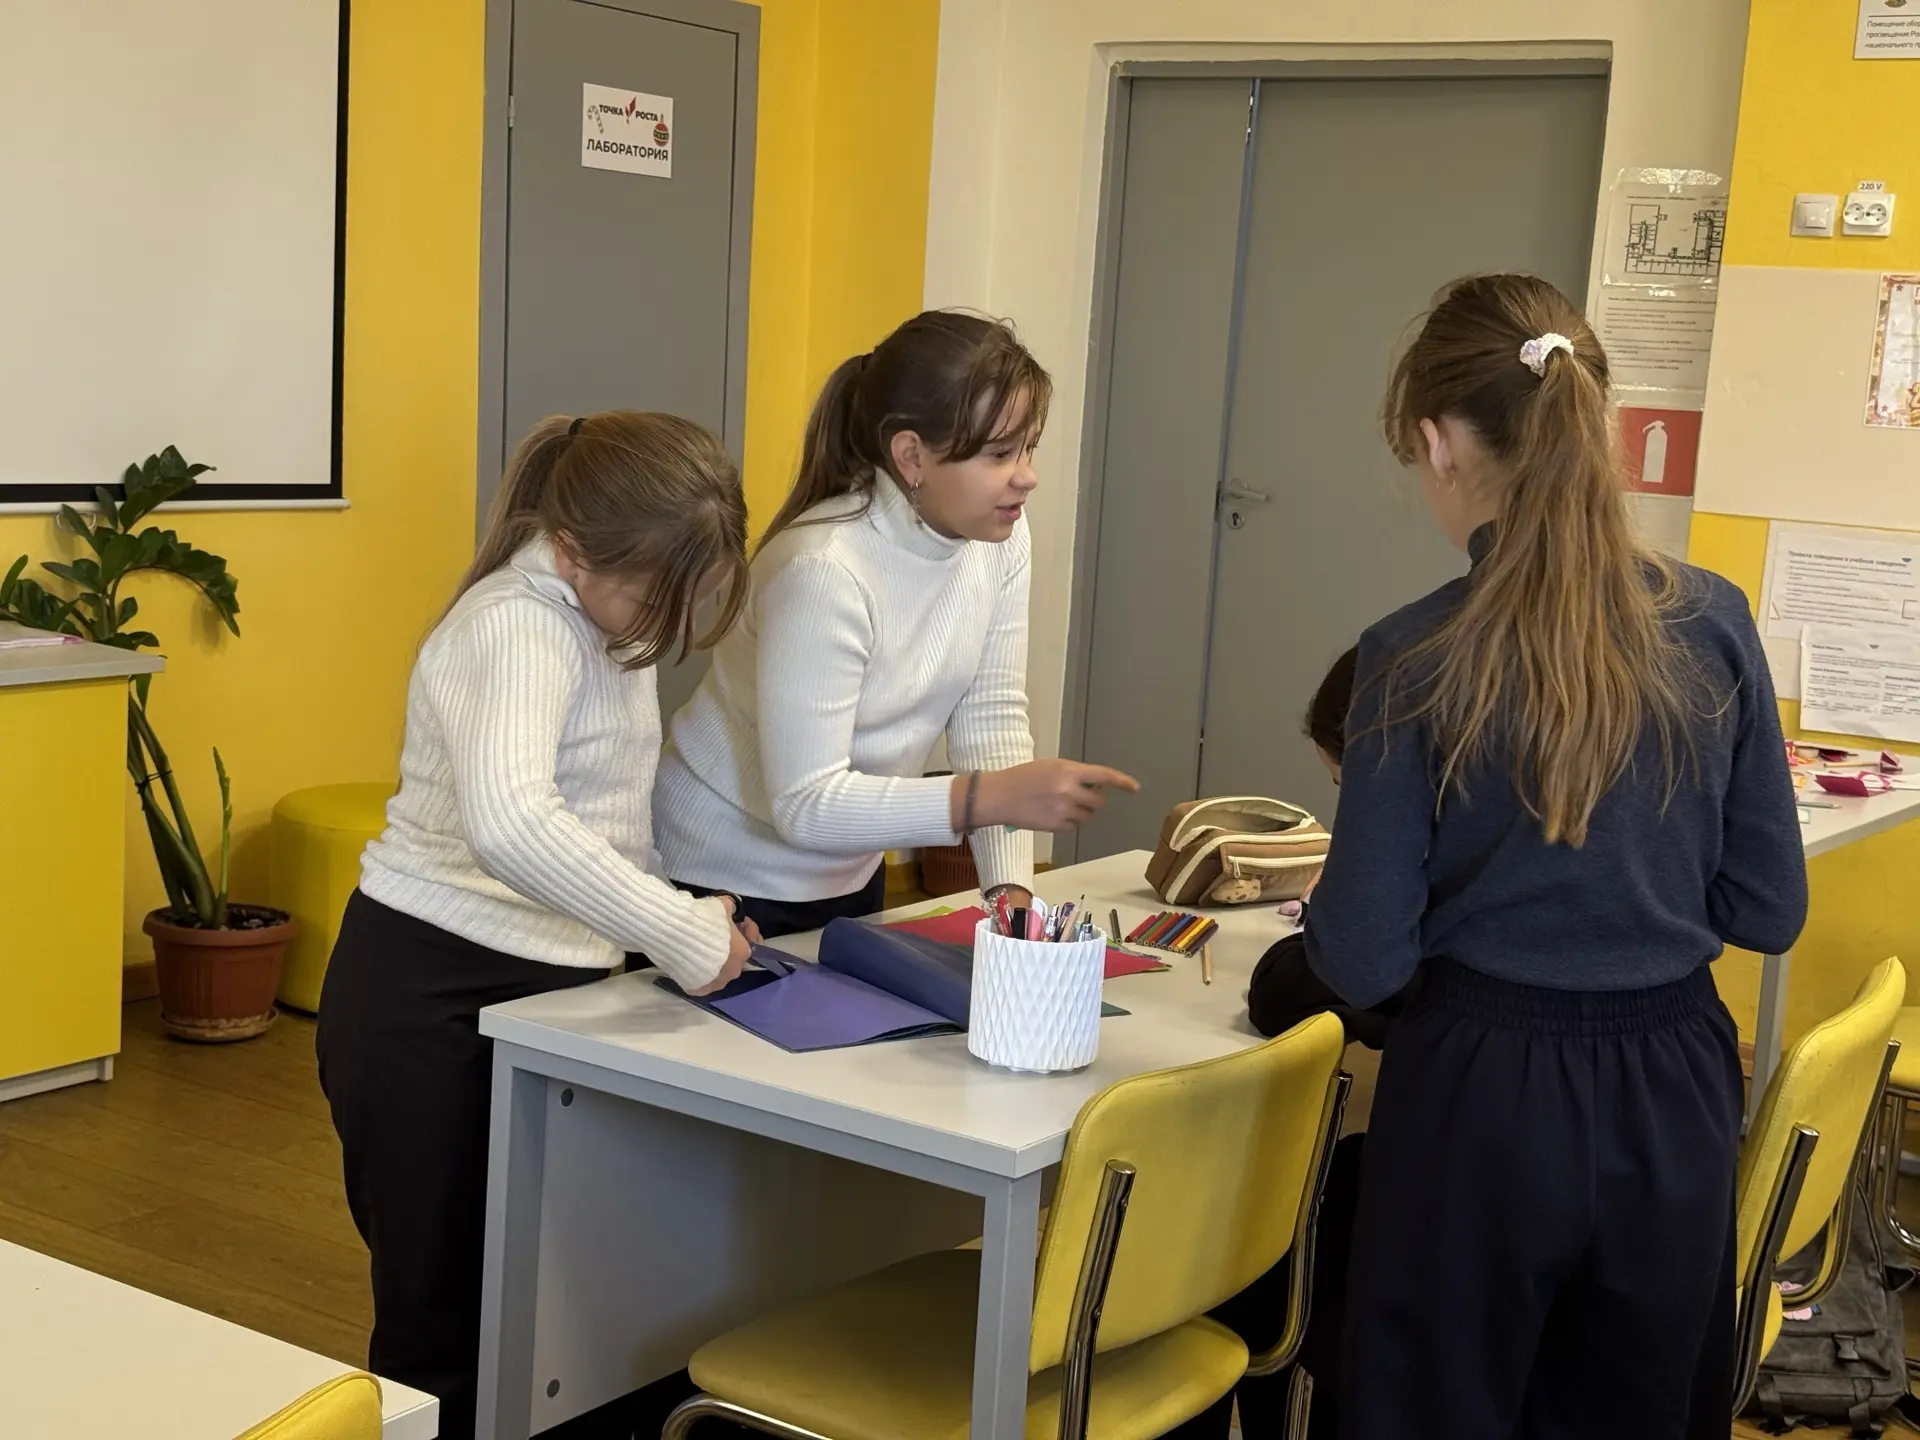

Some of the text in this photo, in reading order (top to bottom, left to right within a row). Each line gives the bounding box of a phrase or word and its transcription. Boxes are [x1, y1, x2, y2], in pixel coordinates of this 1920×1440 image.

[599, 104, 658, 121] ТОЧКА РОСТА
[586, 138, 668, 161] ЛАБОРАТОРИЯ
